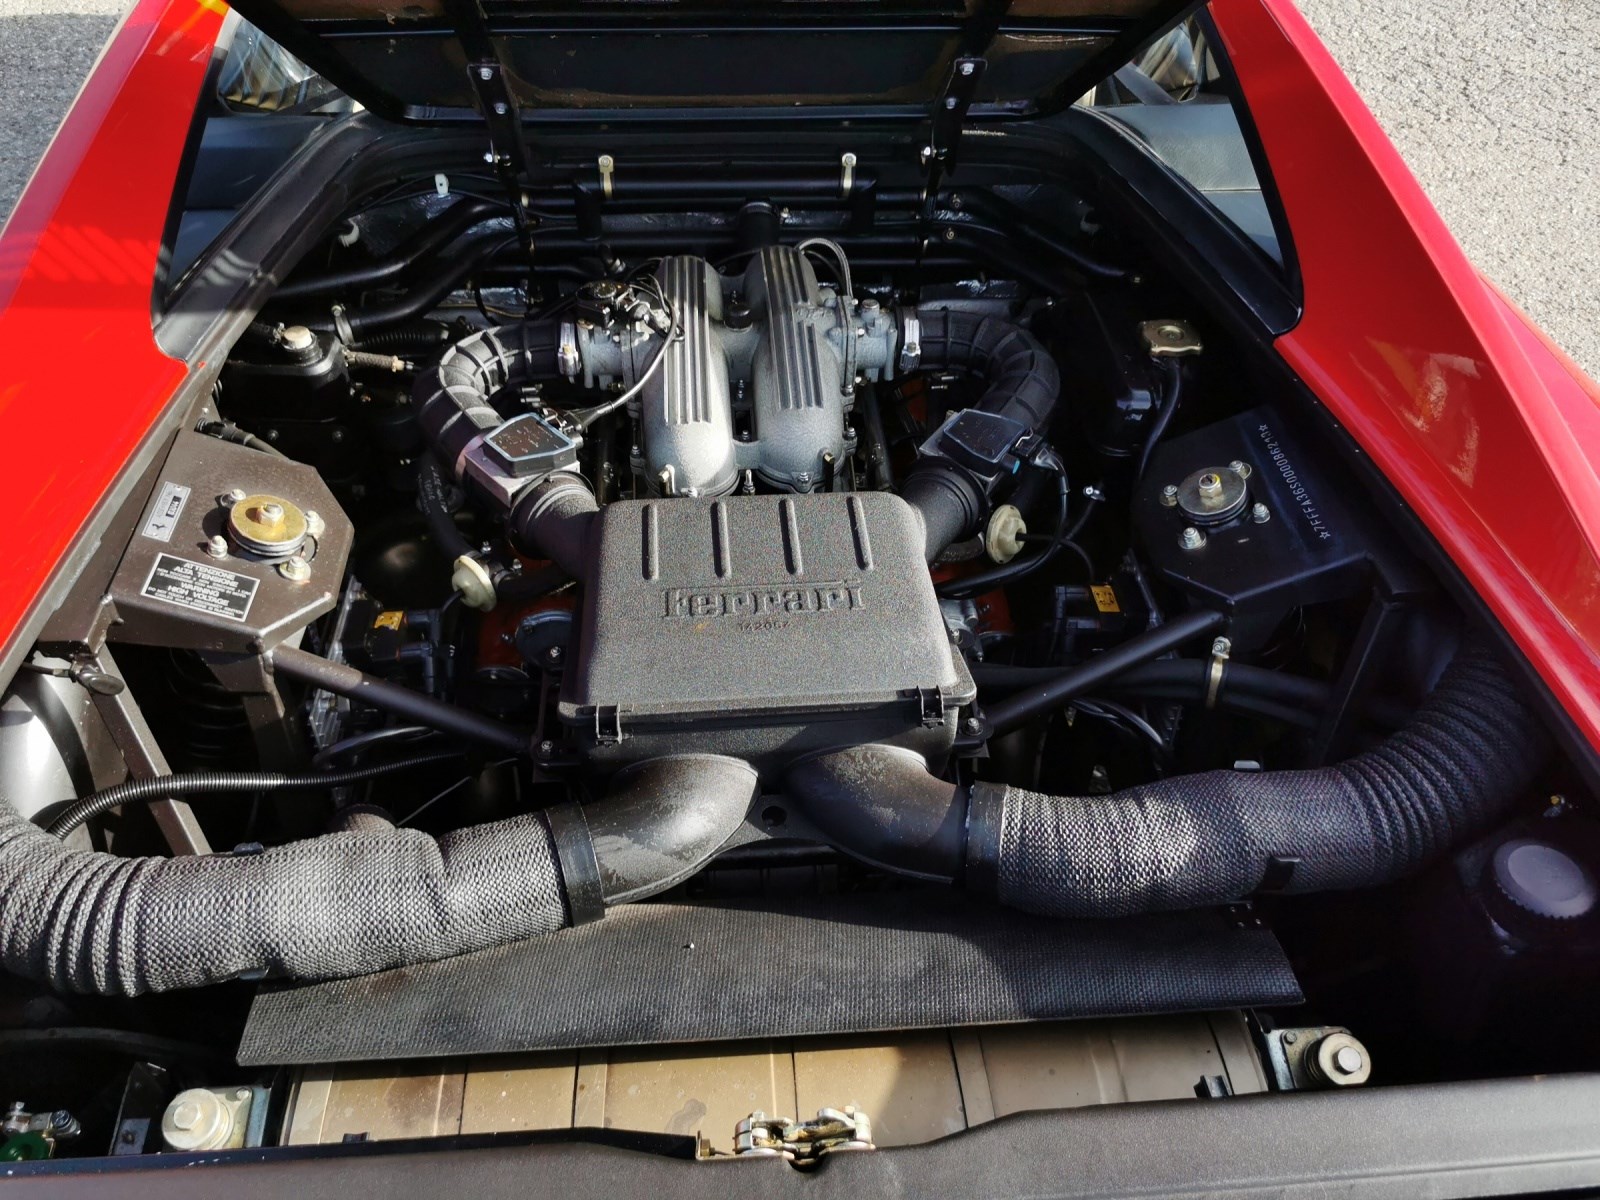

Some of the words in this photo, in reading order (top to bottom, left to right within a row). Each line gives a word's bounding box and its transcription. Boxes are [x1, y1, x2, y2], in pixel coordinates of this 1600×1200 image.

[173, 566, 194, 576] ALTA
[197, 571, 239, 588] TENSIONE
[184, 562, 236, 581] ATTENZIONE
[167, 585, 189, 596] HIGH
[193, 591, 230, 607] VOLTAGE
[181, 582, 220, 597] WARNING
[660, 580, 866, 620] Ferrari
